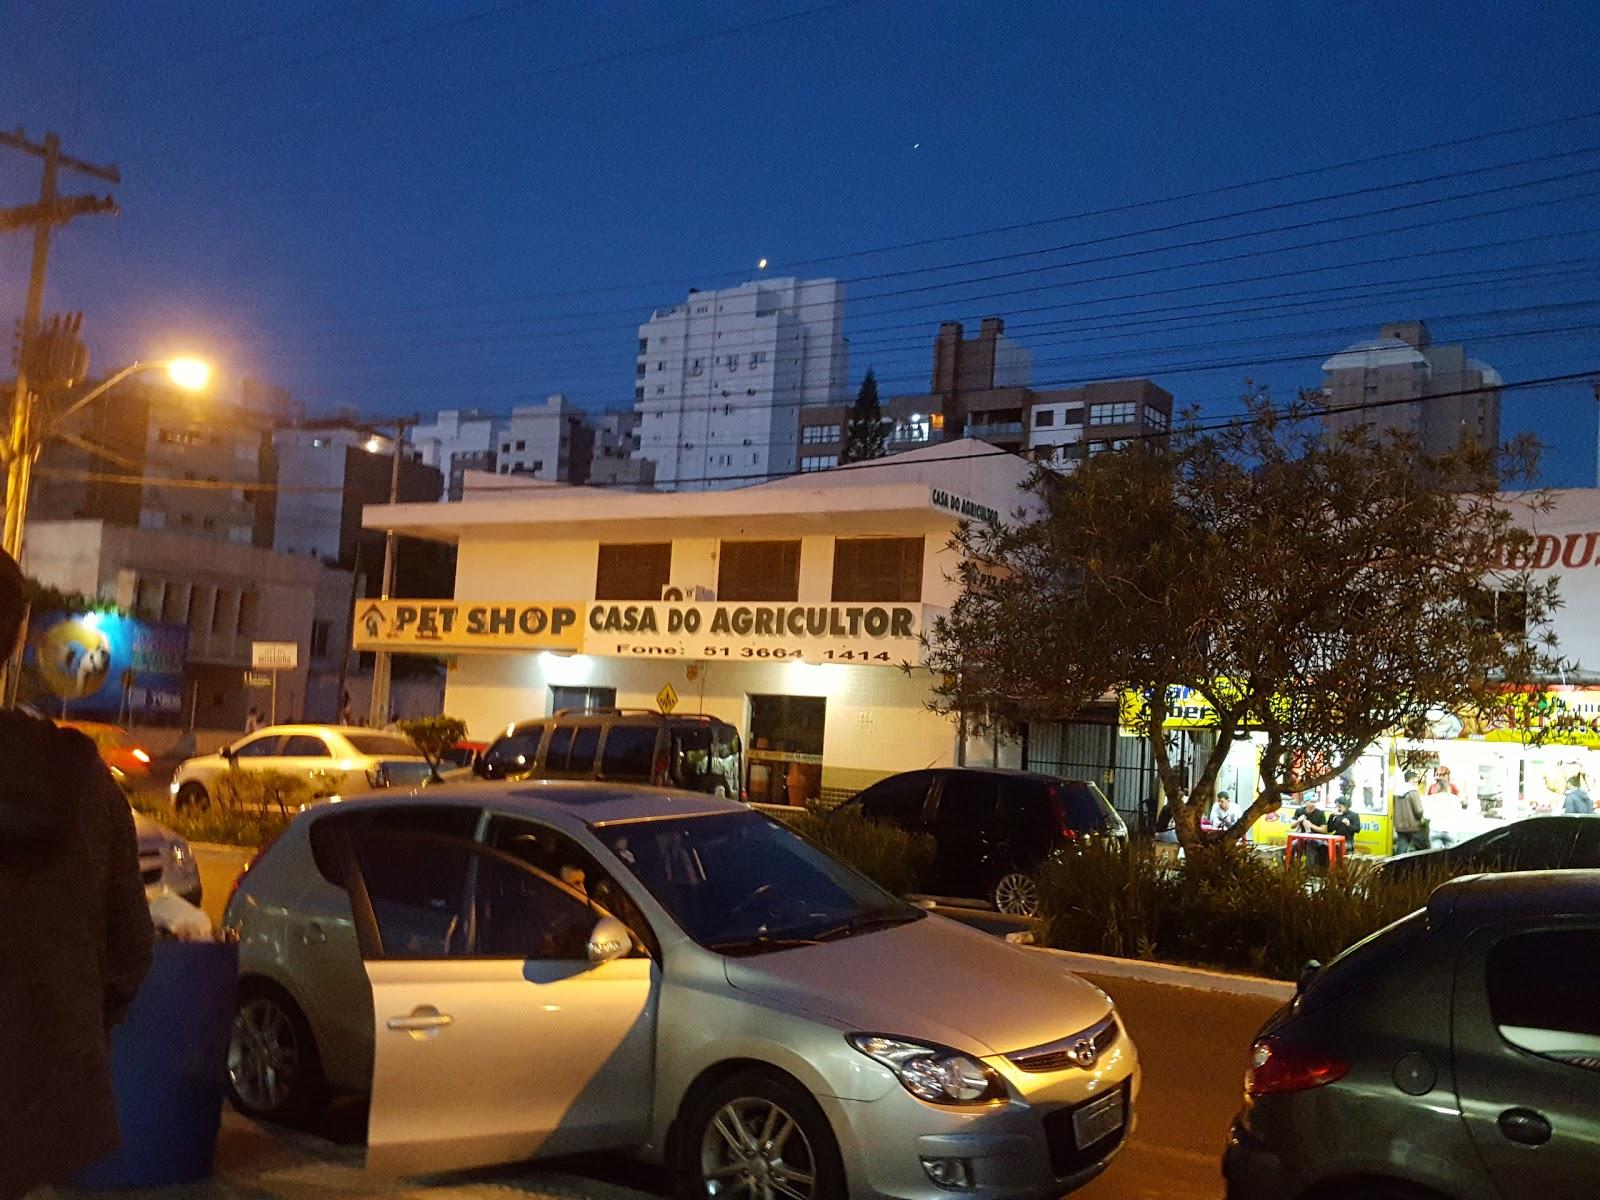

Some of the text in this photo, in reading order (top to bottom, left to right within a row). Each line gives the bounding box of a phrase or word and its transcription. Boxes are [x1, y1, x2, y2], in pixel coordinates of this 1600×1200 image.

[932, 488, 950, 509] CASA
[950, 495, 961, 512] DO
[396, 606, 577, 638] PET SHOP
[589, 605, 913, 637] CASA DO AGRICULTOR
[704, 647, 731, 657] 51
[740, 648, 805, 659] 3664
[823, 650, 891, 662] 1414
